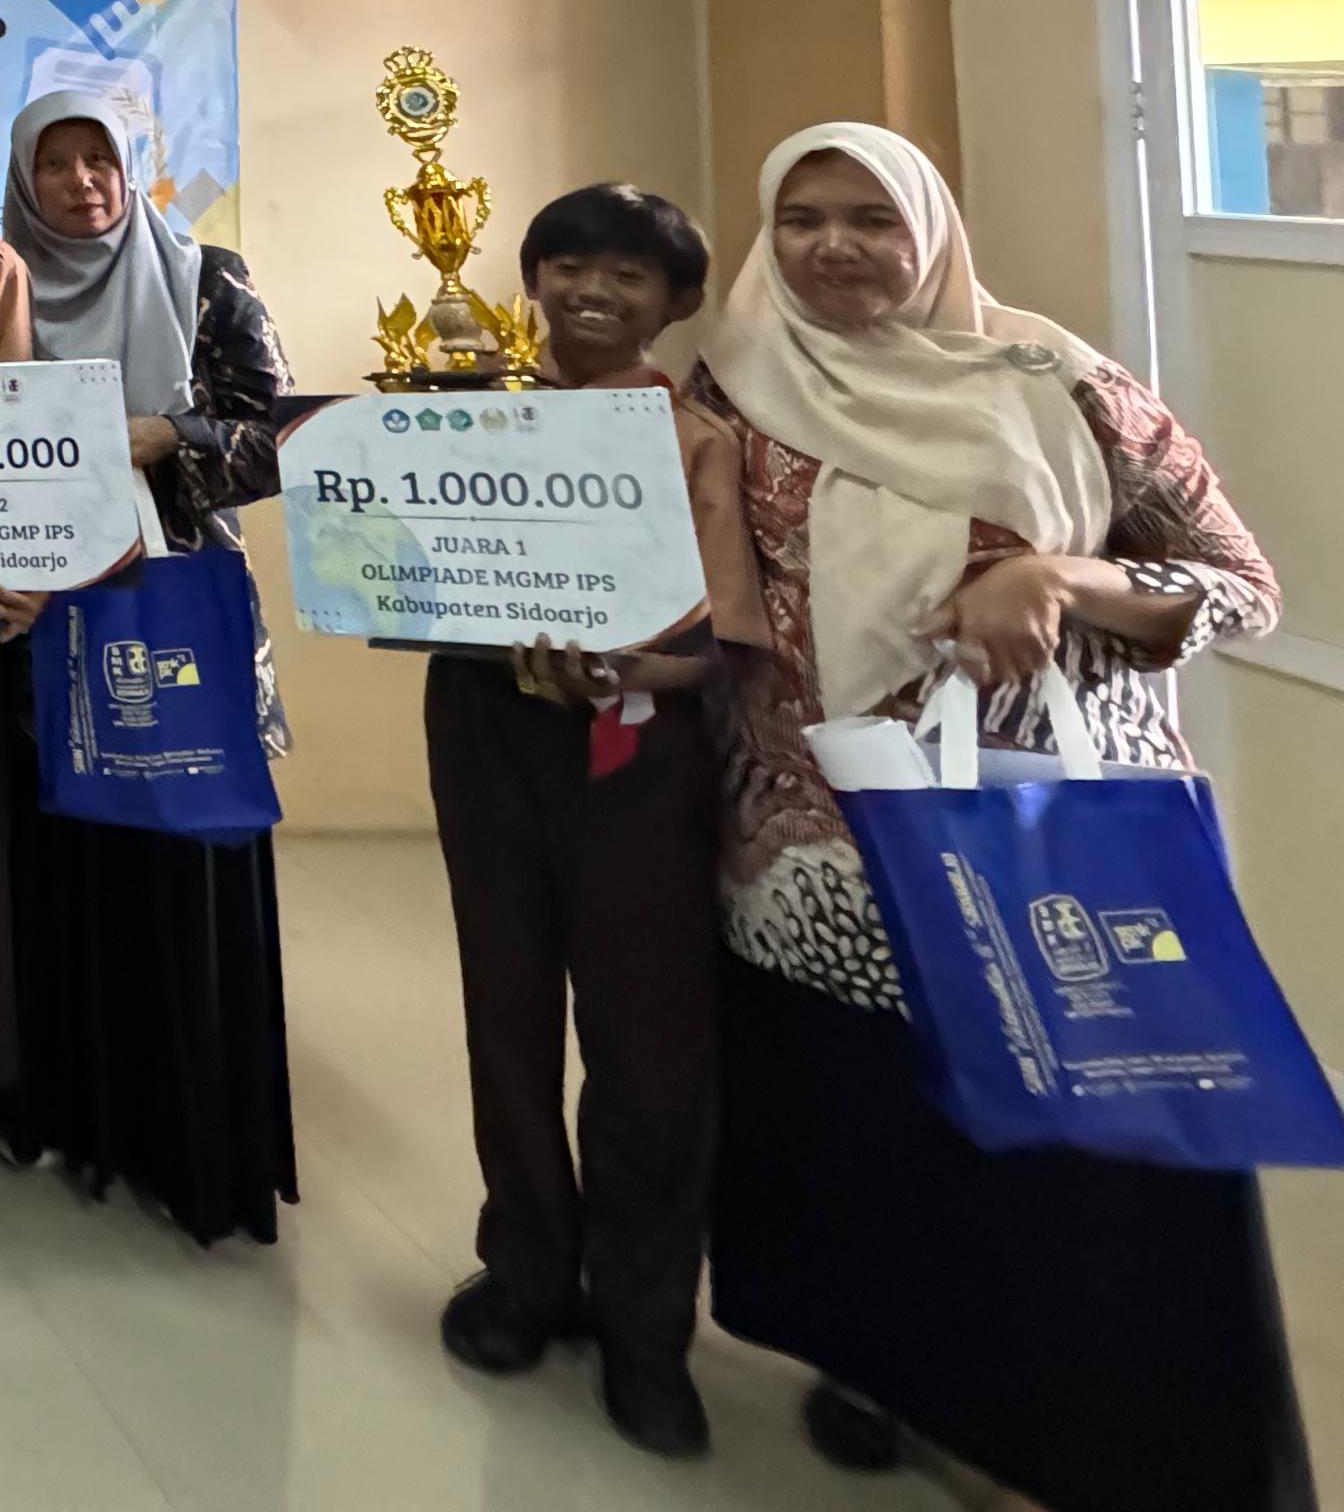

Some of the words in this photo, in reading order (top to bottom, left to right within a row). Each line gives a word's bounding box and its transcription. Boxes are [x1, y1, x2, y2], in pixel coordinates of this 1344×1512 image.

[313, 469, 389, 513] Rp.
[399, 469, 644, 510] 1.000.000
[44, 524, 75, 540] IPS
[430, 535, 511, 556] JUARA
[515, 539, 528, 556] 1
[361, 563, 490, 588] OLIMPIADE
[494, 568, 571, 590] MGMP
[575, 573, 617, 593] IPS
[375, 594, 502, 619] Kabupaten
[505, 601, 609, 629] Sidoarjo
